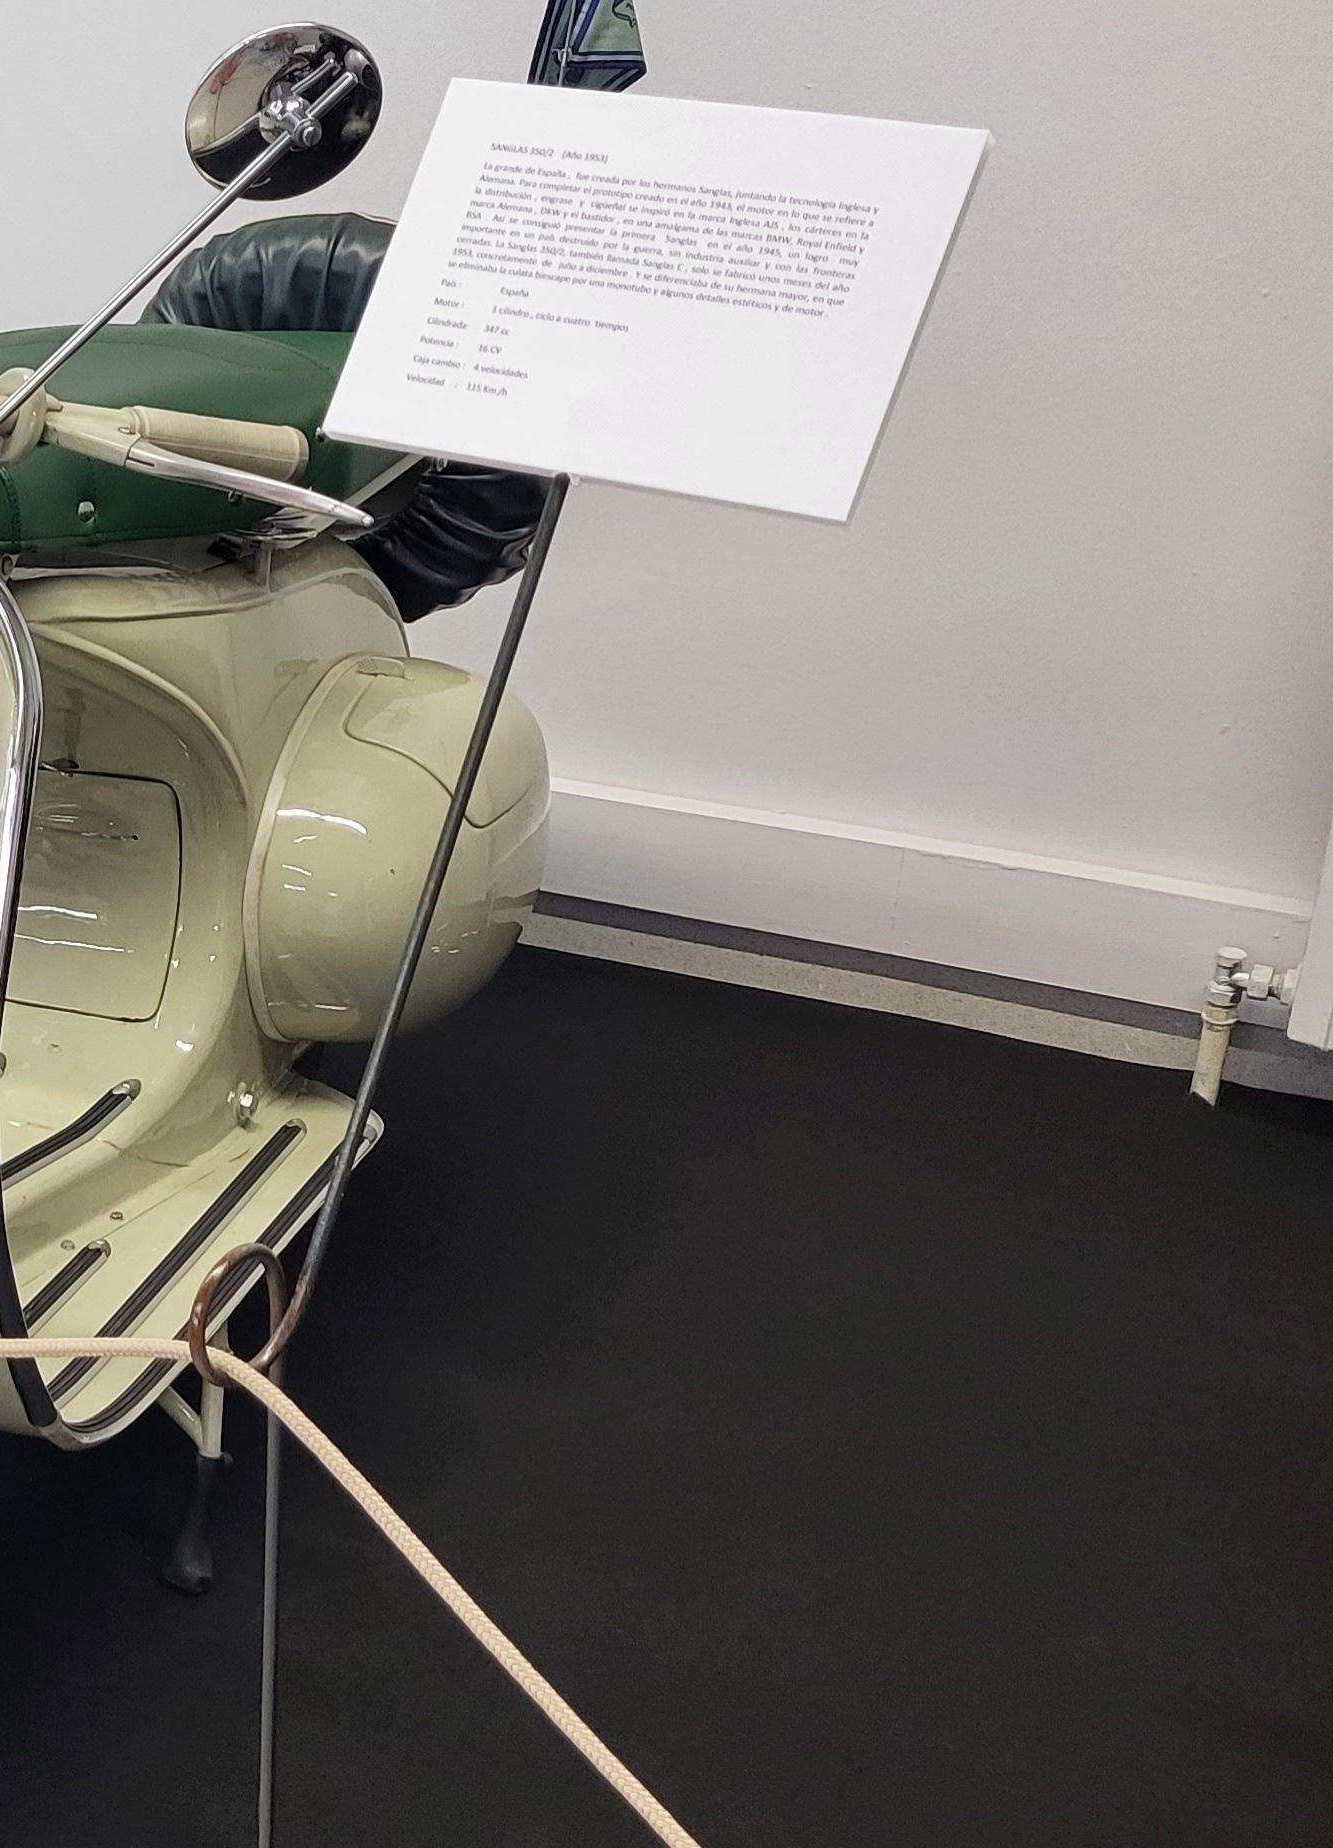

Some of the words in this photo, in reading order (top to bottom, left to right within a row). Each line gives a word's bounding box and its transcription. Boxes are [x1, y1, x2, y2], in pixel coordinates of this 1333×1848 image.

[490, 143, 528, 154] SANGLAS
[493, 164, 523, 173] grande
[575, 171, 590, 181] fue
[591, 175, 620, 184] creada
[621, 178, 636, 187] por
[638, 178, 651, 188] los
[653, 180, 696, 193] hermanos
[734, 190, 777, 202] juntando
[519, 178, 537, 188] Para
[538, 183, 581, 192] completar
[592, 188, 633, 200] prototipo
[634, 193, 665, 203] creado
[689, 198, 707, 208] año
[802, 212, 820, 221] que
[834, 215, 866, 226] refiere
[470, 200, 495, 209] marca
[496, 202, 533, 213] Alemana
[636, 220, 653, 228] una
[654, 222, 700, 233] amalgama
[701, 226, 714, 235] de
[715, 227, 728, 237] las
[731, 231, 763, 241] marcas
[796, 237, 822, 249] Royal
[484, 188, 532, 200] distribución
[540, 196, 573, 206] engrase
[698, 214, 726, 223] marca
[788, 222, 801, 232] los
[461, 223, 506, 236] importante
[602, 242, 618, 250] por
[685, 250, 724, 263] industria
[727, 257, 760, 267] auxiliar
[774, 263, 792, 272] con
[813, 266, 855, 280] fronteras
[466, 210, 482, 220] BSA
[492, 214, 505, 223] Así
[564, 223, 605, 234] presentar
[621, 231, 656, 241] primera
[664, 234, 697, 246] Sanglas
[706, 241, 719, 249] en
[735, 243, 753, 253] año
[787, 251, 800, 259] un
[804, 251, 829, 263] logro
[838, 257, 860, 268] muy
[476, 252, 537, 265] concretamente
[654, 274, 708, 288] diferenciaba
[736, 284, 776, 297] hermana
[812, 296, 825, 304] en
[826, 297, 845, 306] que
[507, 241, 537, 253] Sanglas
[642, 258, 674, 270] Sanglas
[691, 265, 710, 275] solo
[758, 274, 780, 284] unos
[783, 278, 812, 288] meses
[814, 281, 830, 290] del
[831, 283, 850, 293] año
[508, 268, 533, 278] culata
[571, 277, 588, 285] por
[588, 279, 605, 288] una
[606, 282, 652, 294] monotubo
[660, 286, 693, 300] algunos
[695, 292, 730, 304] detalles
[732, 298, 772, 310] estéticos
[781, 303, 794, 313] de
[535, 312, 555, 322] ciclo
[563, 316, 591, 326] cuatro
[595, 320, 629, 333] tiempos
[413, 354, 430, 365] Caja
[480, 366, 528, 379] velocidades
[467, 381, 482, 392] 115
